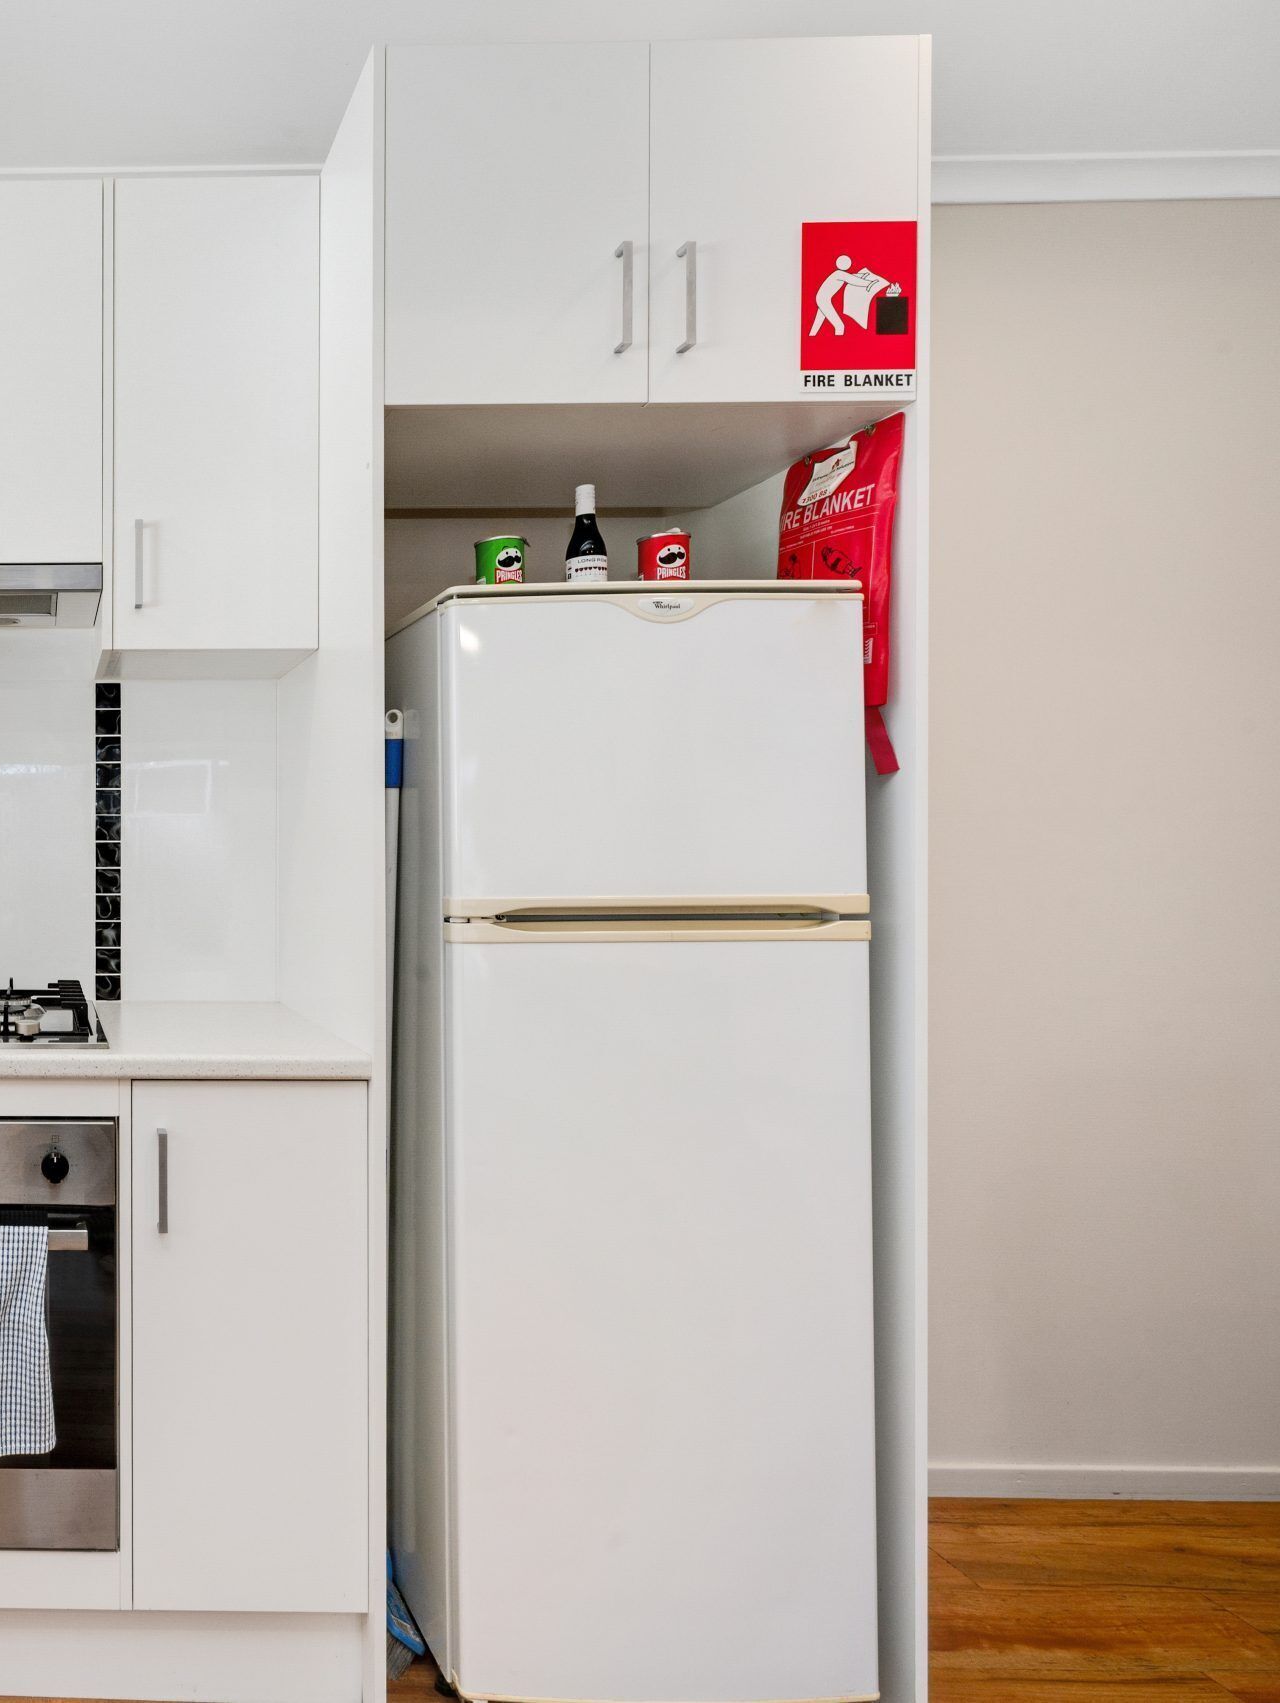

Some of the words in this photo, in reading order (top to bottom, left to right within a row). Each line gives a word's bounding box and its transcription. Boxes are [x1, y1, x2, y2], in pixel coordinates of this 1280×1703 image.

[804, 375, 835, 387] FIRE
[844, 374, 913, 387] BLANKET
[803, 484, 875, 524] BLANKET
[496, 569, 523, 583] PRINGLES
[657, 566, 686, 580] PRINGLES
